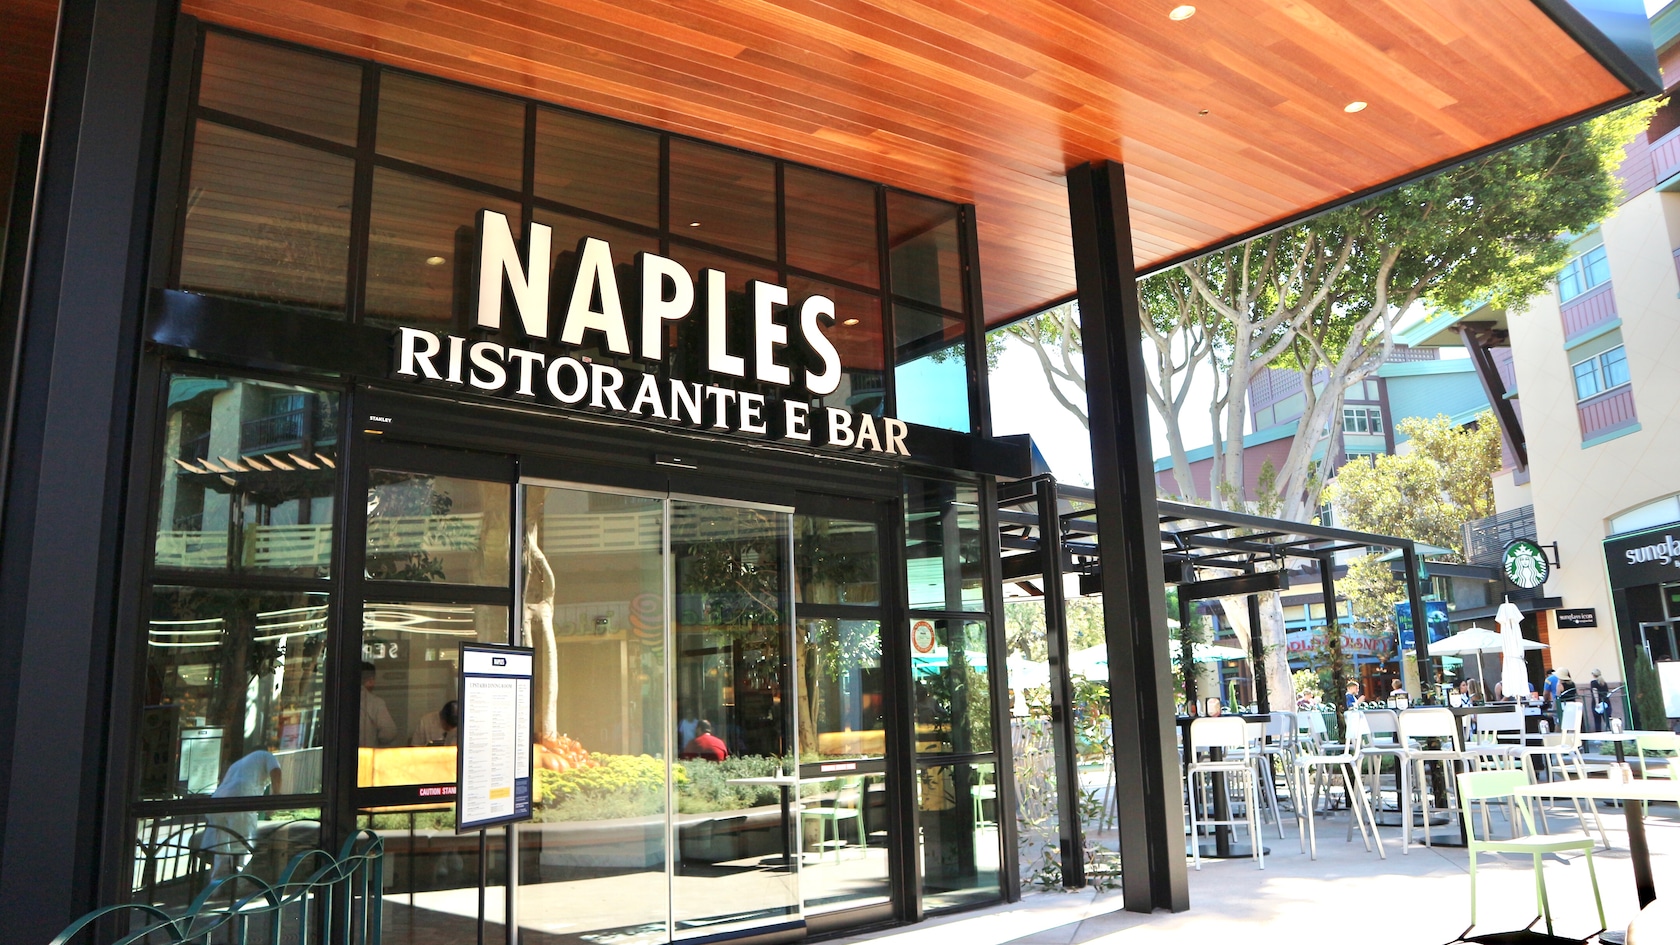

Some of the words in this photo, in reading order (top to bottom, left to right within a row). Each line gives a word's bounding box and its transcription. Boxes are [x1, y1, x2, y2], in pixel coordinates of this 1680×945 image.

[477, 208, 842, 395] NAPLES
[369, 415, 393, 423] STANLEY
[397, 327, 767, 434] RISTORANTE
[784, 399, 812, 441] E
[828, 406, 911, 457] BAR
[420, 787, 441, 796] CAUTION
[442, 786, 457, 795] STAN
